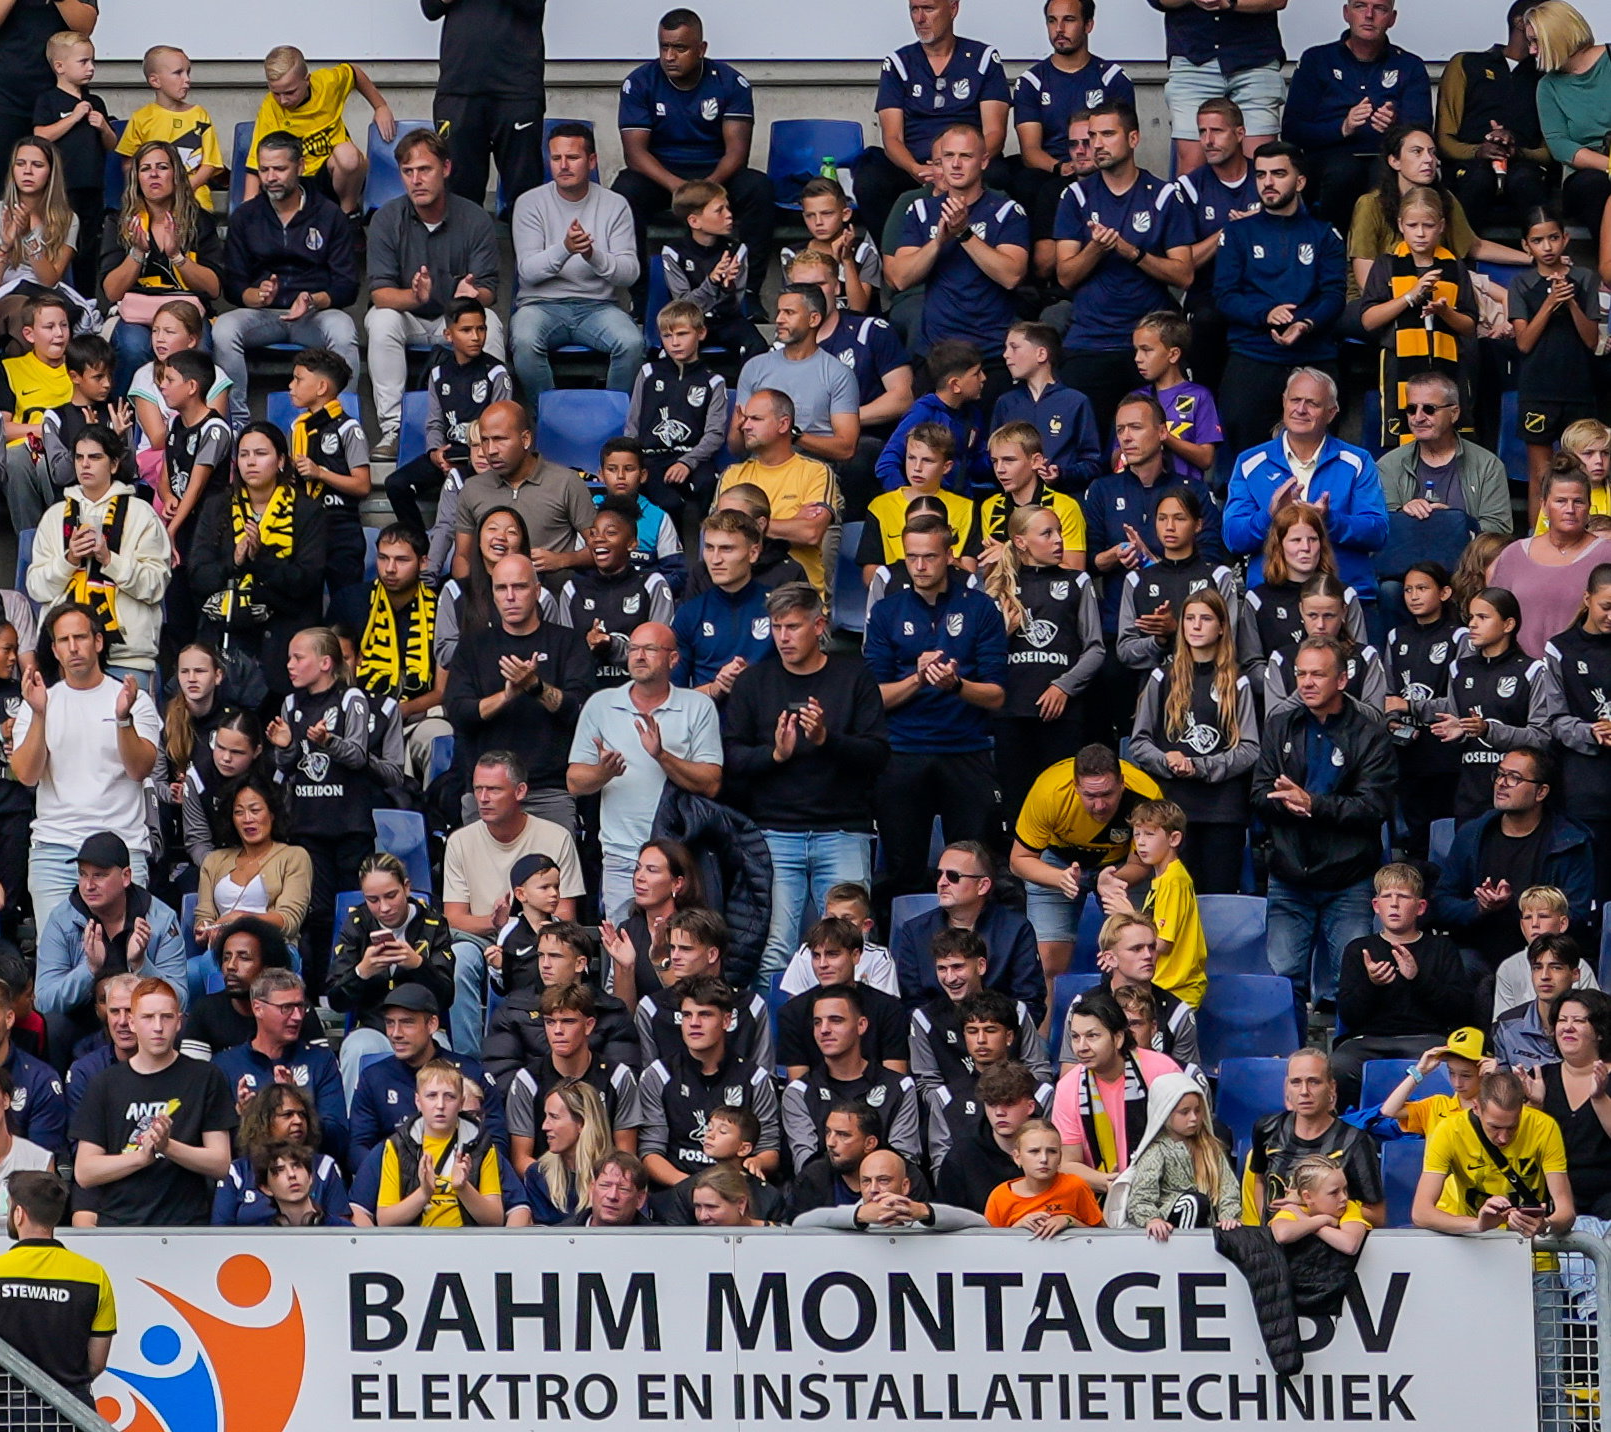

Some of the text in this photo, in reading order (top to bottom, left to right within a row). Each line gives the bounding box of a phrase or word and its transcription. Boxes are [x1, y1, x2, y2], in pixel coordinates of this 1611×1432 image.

[295, 783, 344, 797] OSEIDON
[2, 1284, 70, 1303] STEWARD
[349, 1272, 661, 1352] BAHM
[707, 1271, 1231, 1353] MONTAGE
[352, 1373, 1417, 1421] ELEKTRO EN INSTALLATIETECHNIEK
